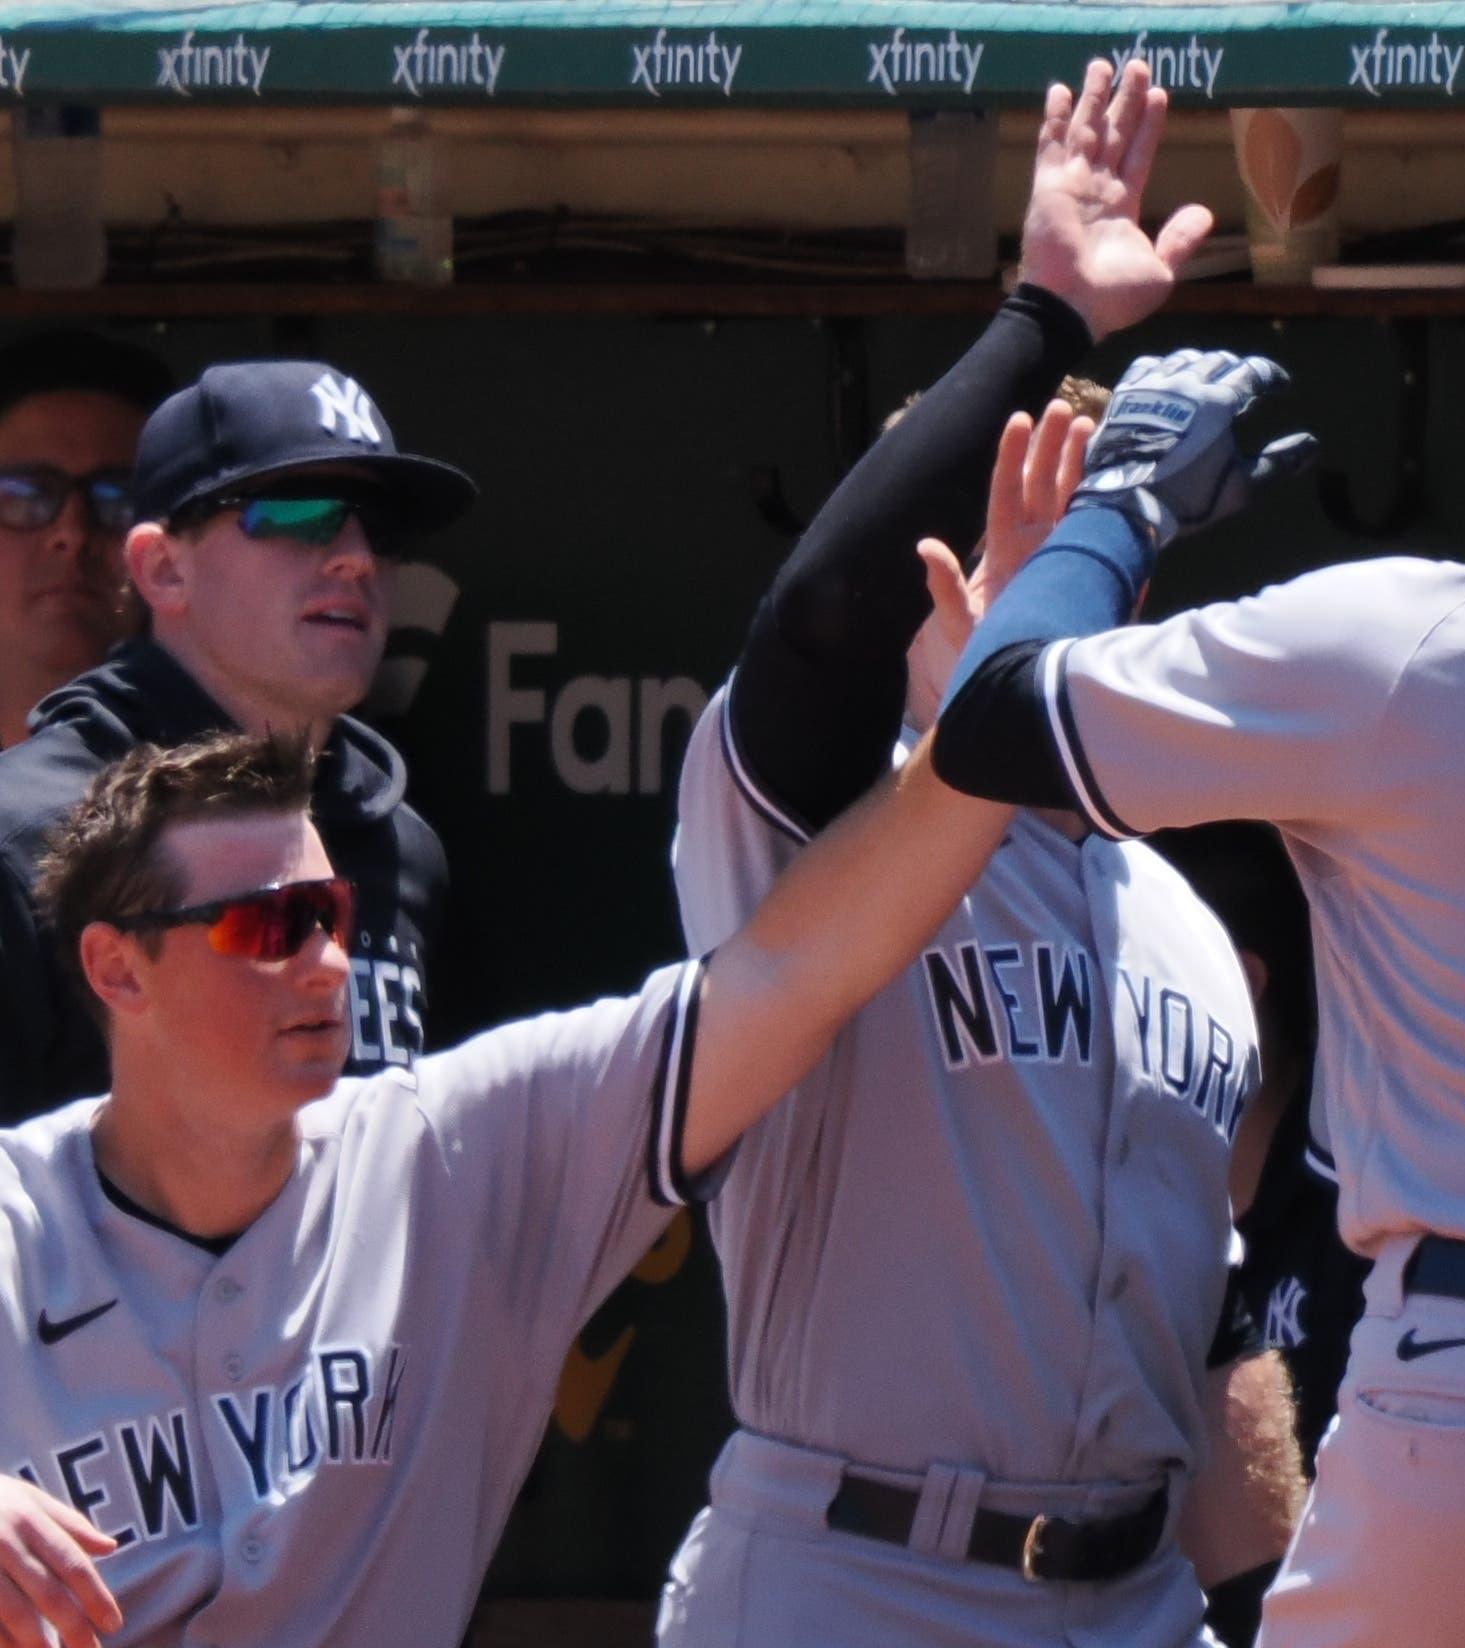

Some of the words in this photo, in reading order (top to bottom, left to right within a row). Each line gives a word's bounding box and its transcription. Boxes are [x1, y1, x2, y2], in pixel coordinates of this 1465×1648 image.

[157, 31, 270, 97] xfinity
[392, 29, 504, 98] xfinity
[631, 29, 742, 97] xfinity
[867, 28, 984, 96] xfinity
[1349, 28, 1465, 95] xfinity
[309, 373, 381, 443] NY
[488, 621, 710, 796] Fan
[921, 938, 1093, 1072] NEW
[16, 1406, 200, 1562] EW
